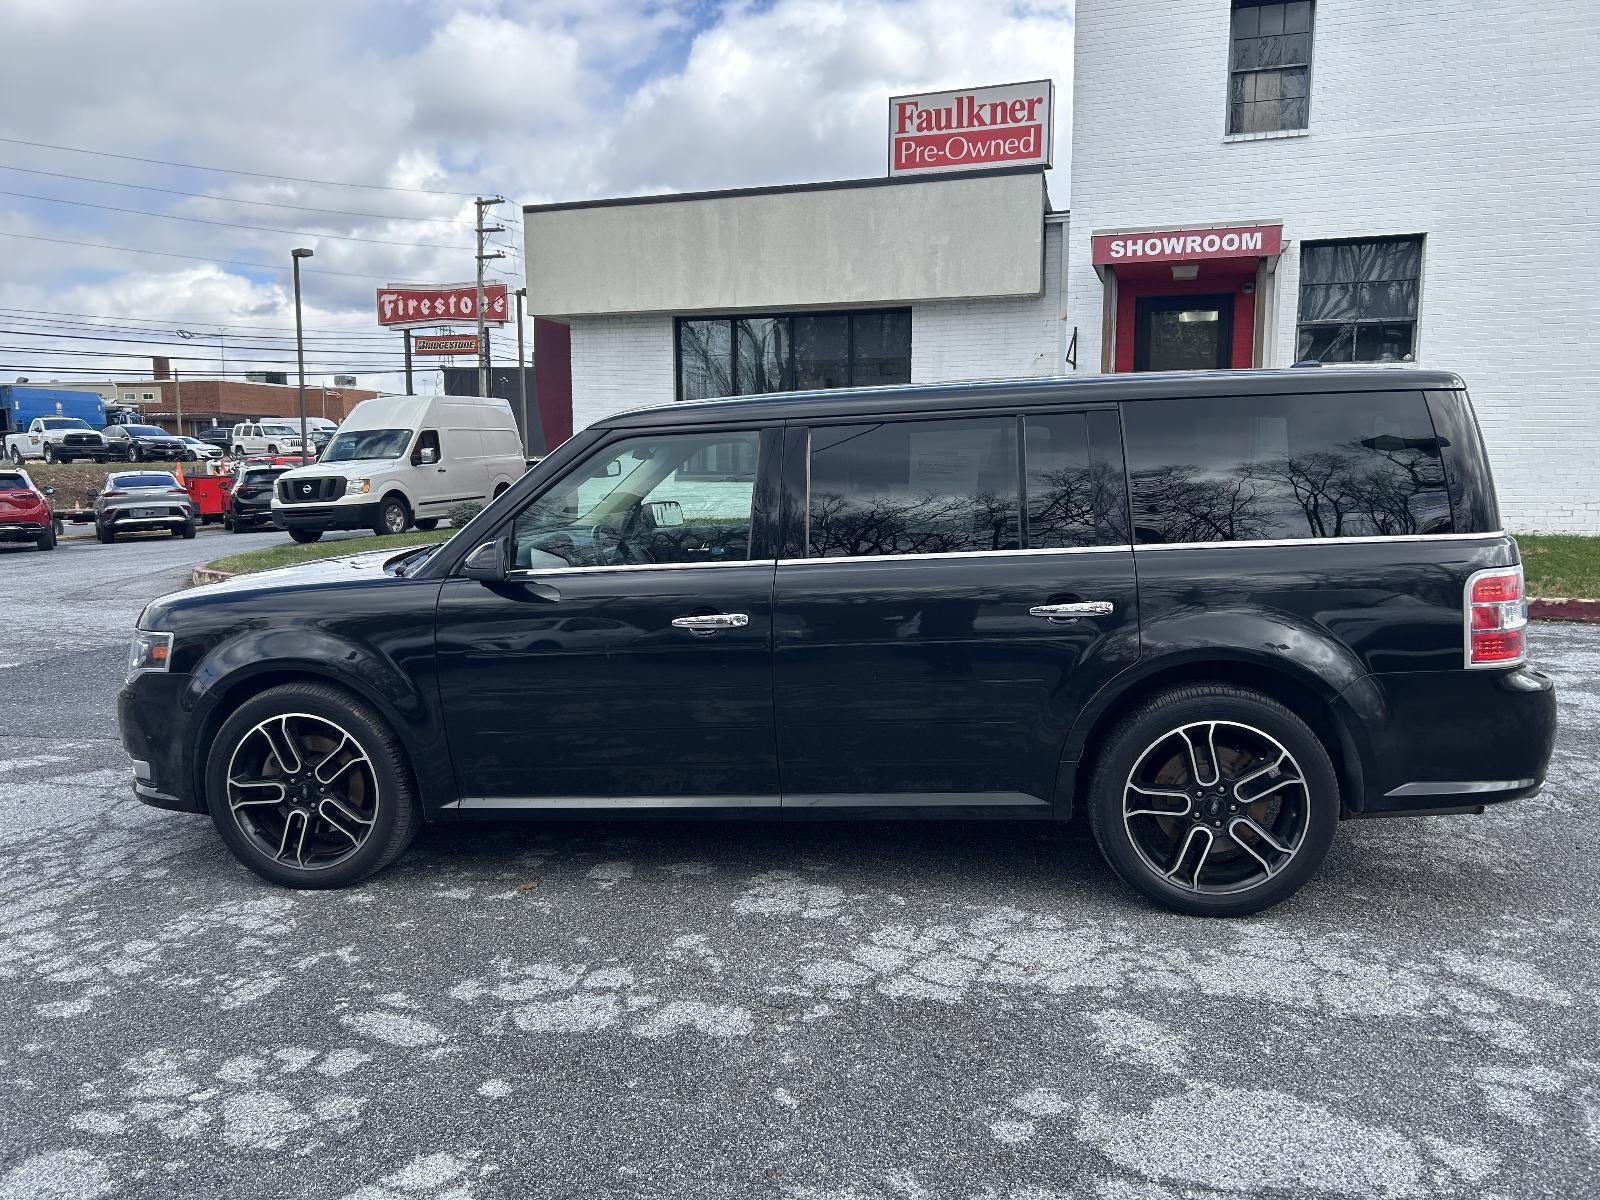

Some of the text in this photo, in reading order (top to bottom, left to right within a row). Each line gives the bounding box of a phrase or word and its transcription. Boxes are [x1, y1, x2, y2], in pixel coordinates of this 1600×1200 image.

[894, 96, 1044, 135] Faulkner
[900, 127, 1036, 164] Pre-Owned
[1109, 232, 1263, 258] SHOWROOM
[417, 340, 476, 350] BRIDGESTONE
